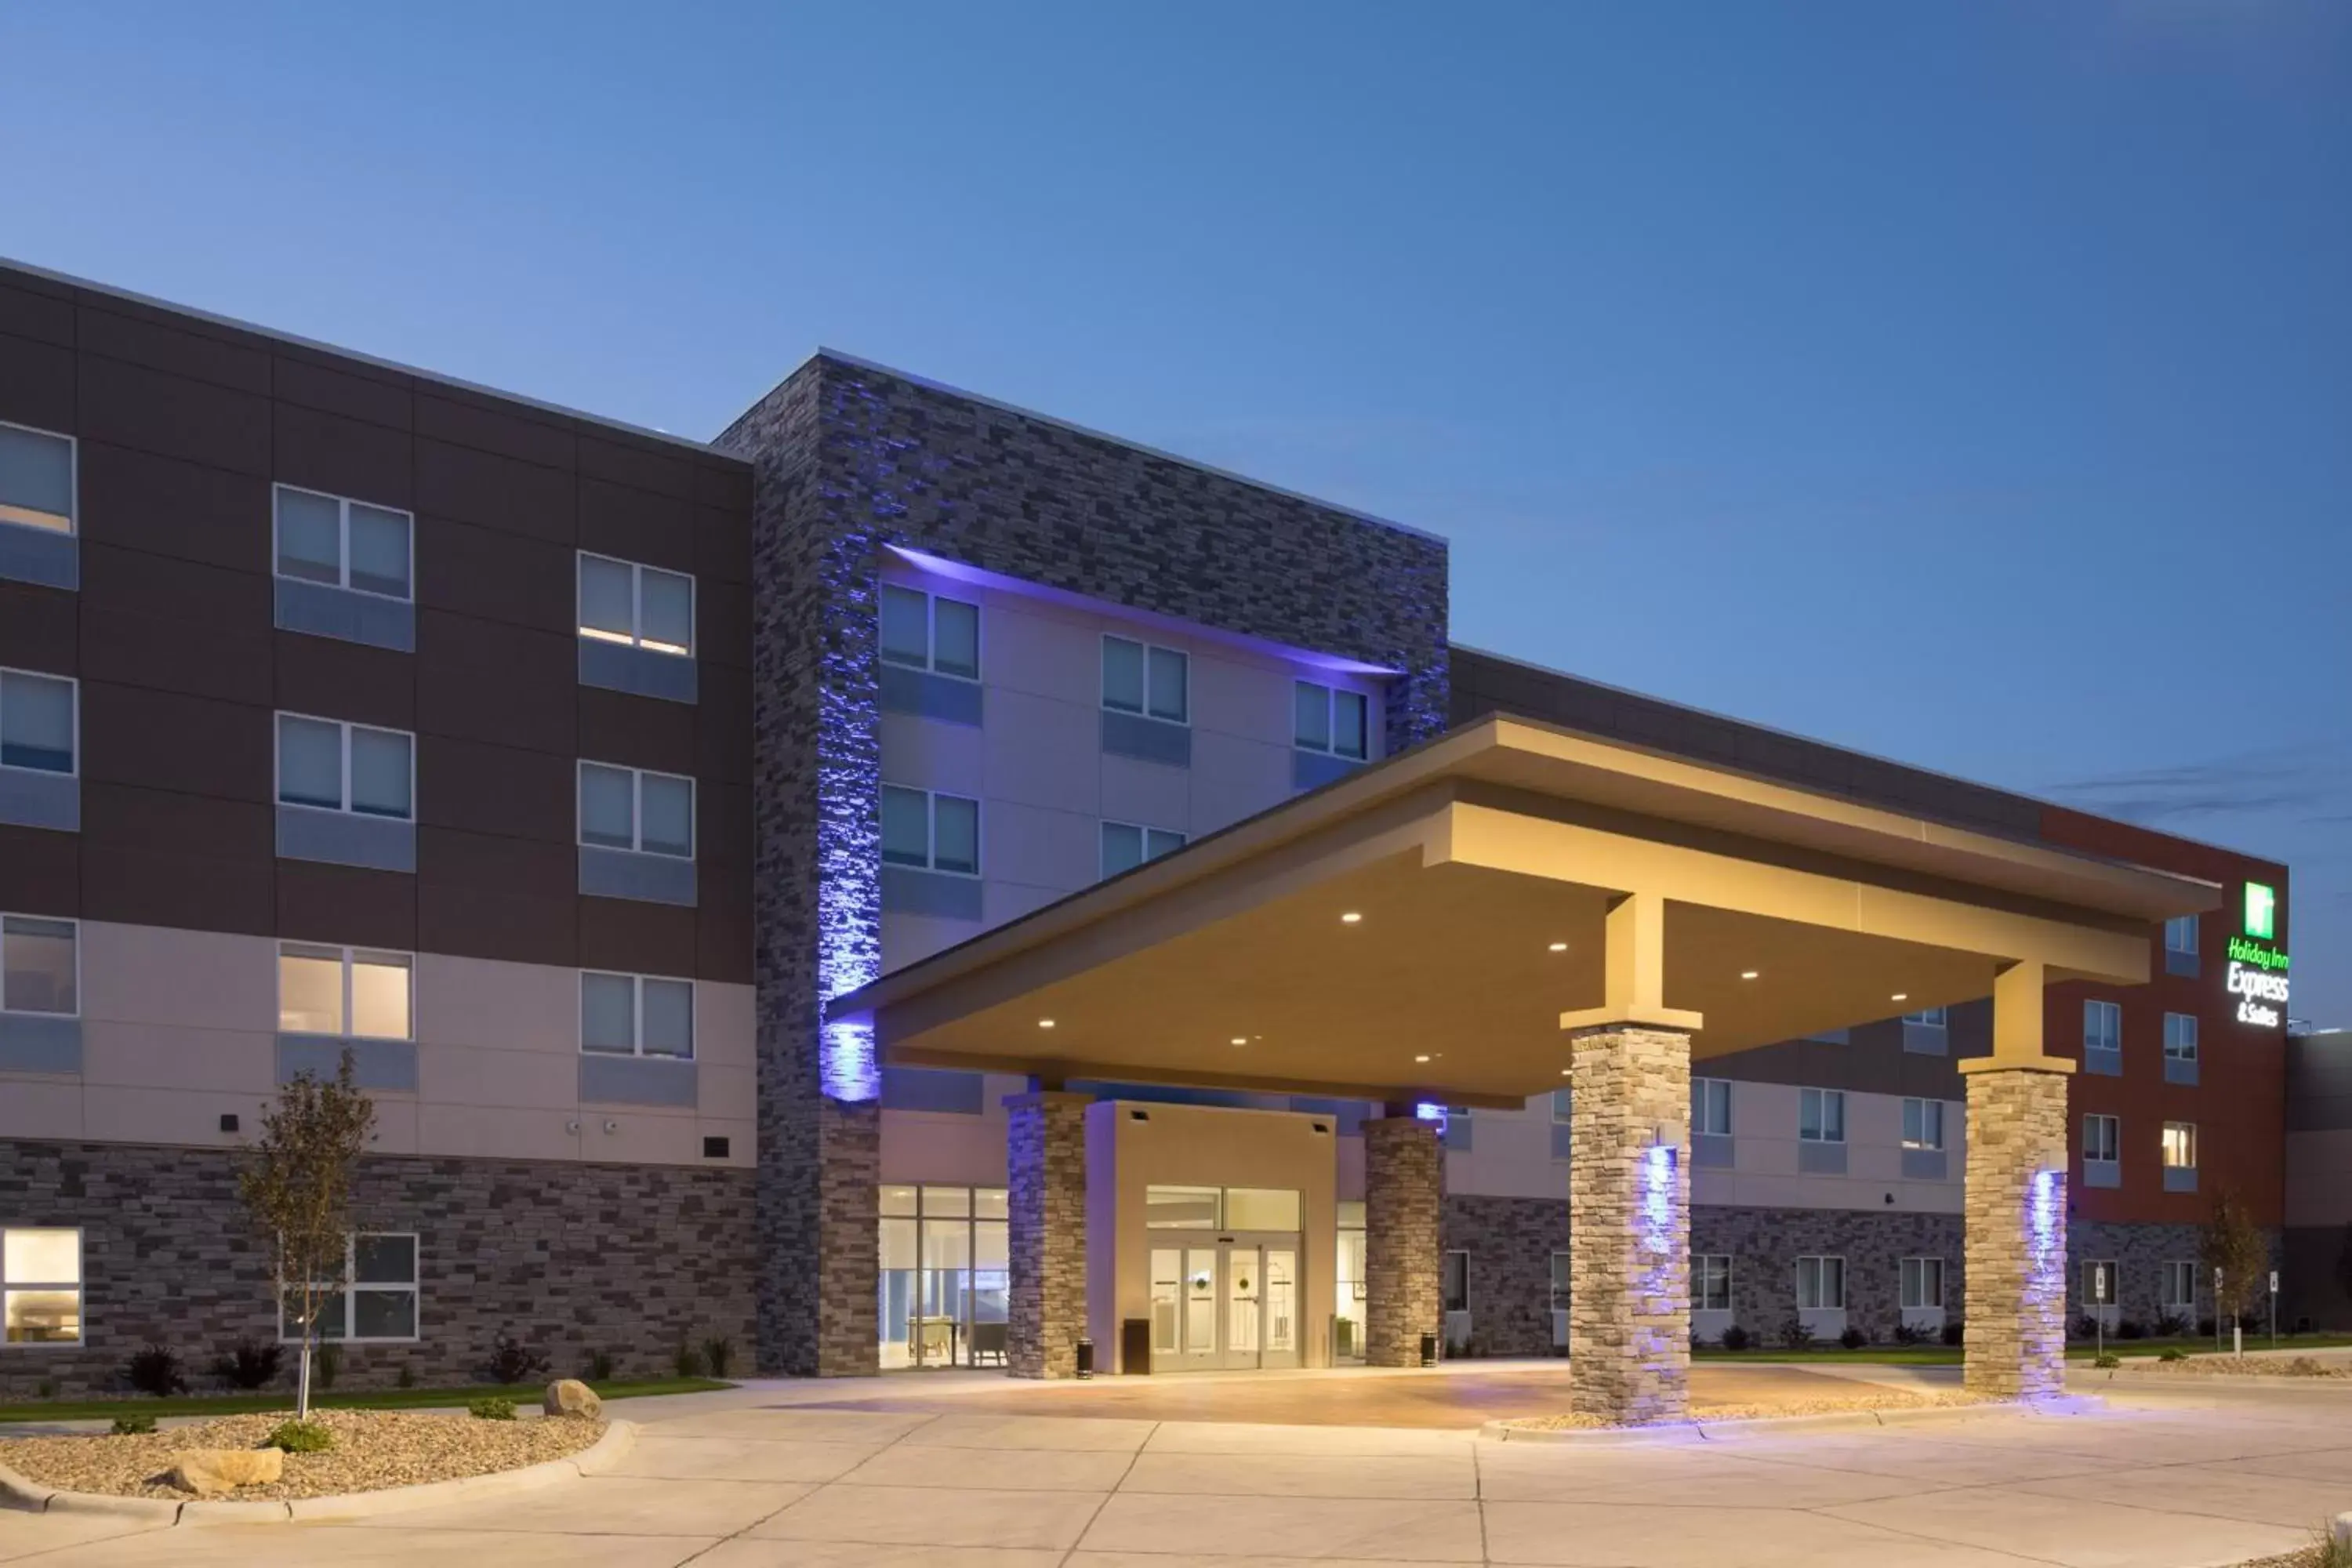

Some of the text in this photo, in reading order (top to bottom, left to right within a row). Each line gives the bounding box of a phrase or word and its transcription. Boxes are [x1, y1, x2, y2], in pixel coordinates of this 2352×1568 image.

[2229, 937, 2288, 971] Holiday Inn
[2228, 961, 2289, 1002] Express
[2237, 1001, 2278, 1027] & Suites
